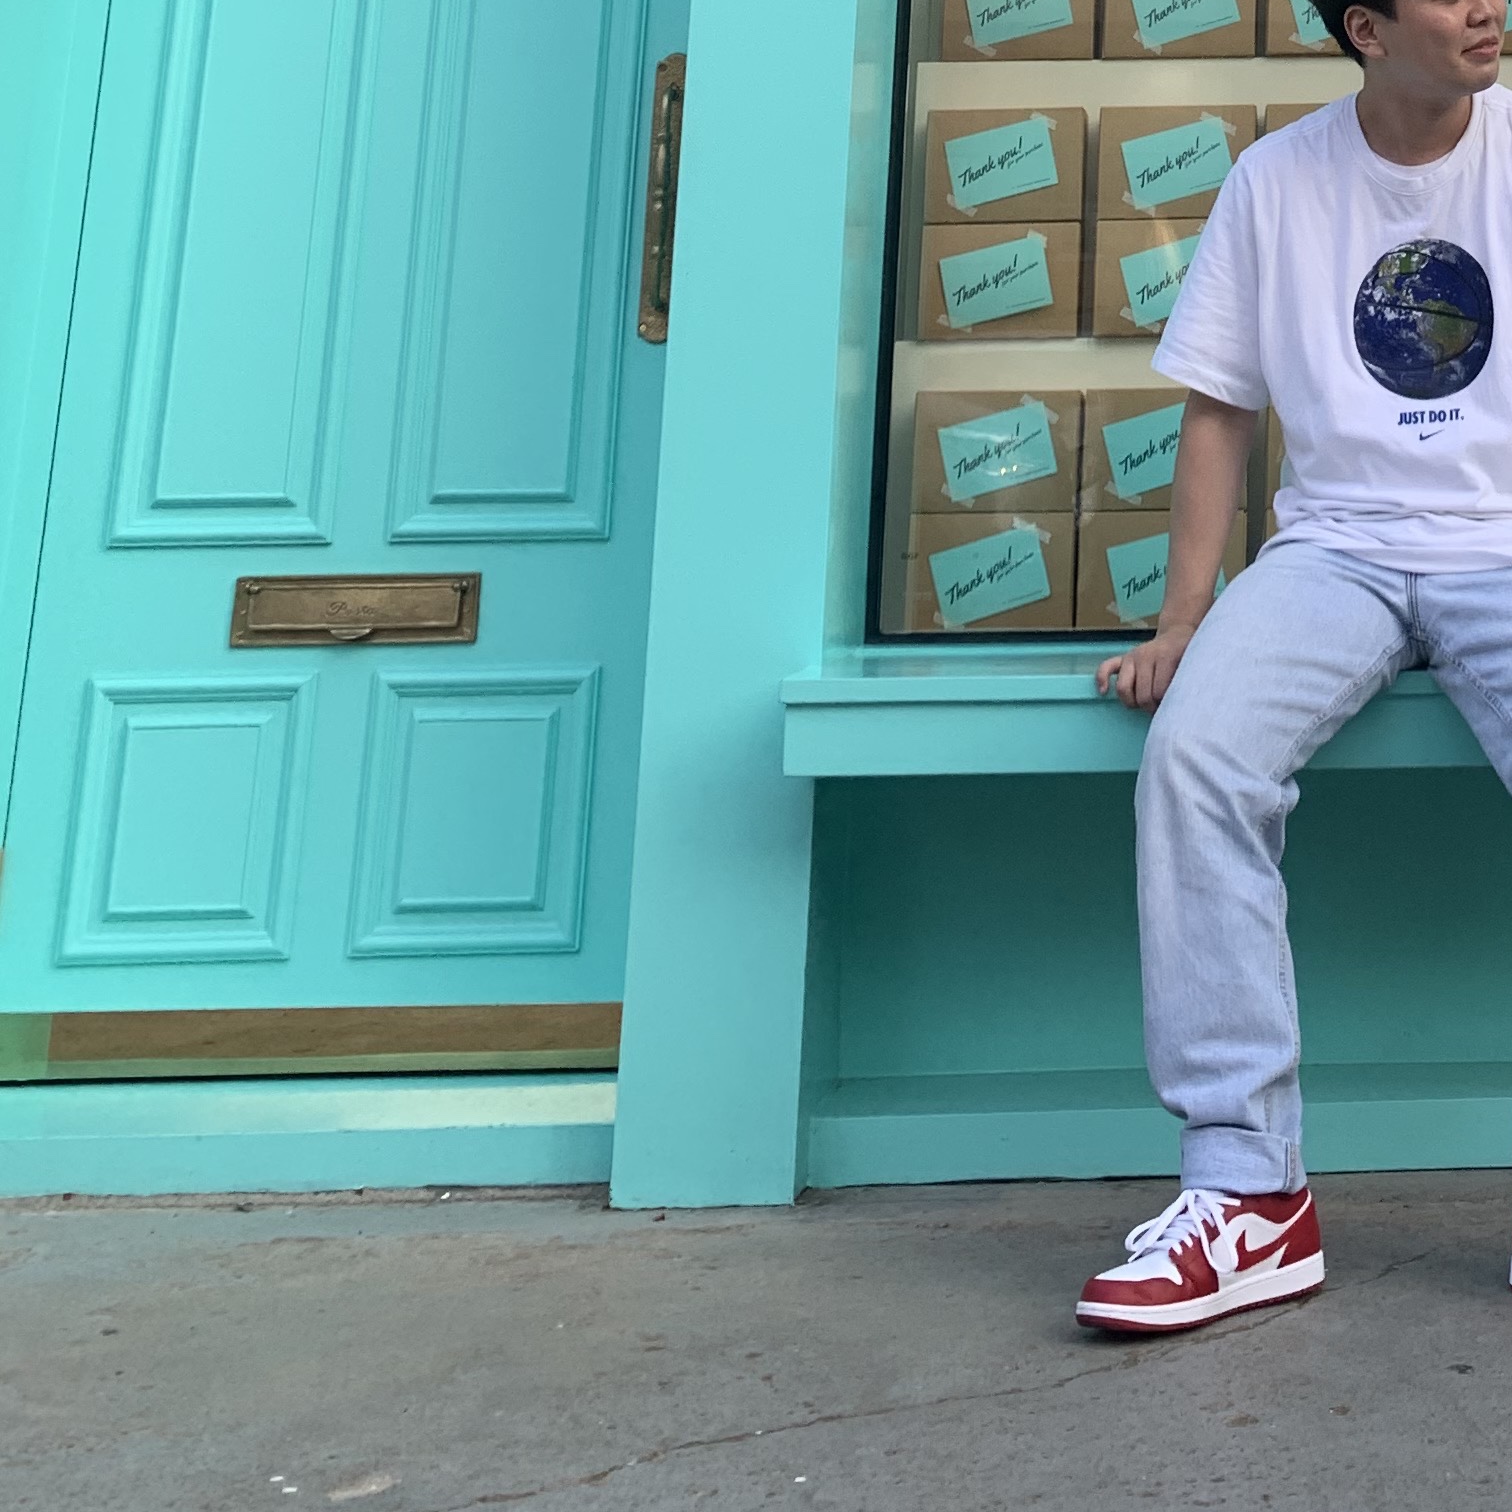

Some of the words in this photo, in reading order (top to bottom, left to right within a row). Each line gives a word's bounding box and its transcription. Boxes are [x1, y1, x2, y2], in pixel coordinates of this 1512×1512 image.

[959, 156, 997, 188] Thank
[999, 136, 1023, 170] you!
[1137, 156, 1174, 189] Thank
[1176, 136, 1199, 170] you!
[953, 274, 991, 307] Thank
[993, 255, 1018, 289] you!
[1136, 271, 1174, 305] Thank
[1397, 410, 1426, 426] JUST
[1428, 409, 1447, 424] DO
[953, 444, 993, 479] Thank
[1118, 439, 1158, 476] Thank
[946, 569, 986, 605] Thank
[987, 546, 1012, 583] you!
[1121, 562, 1163, 600] Thank
